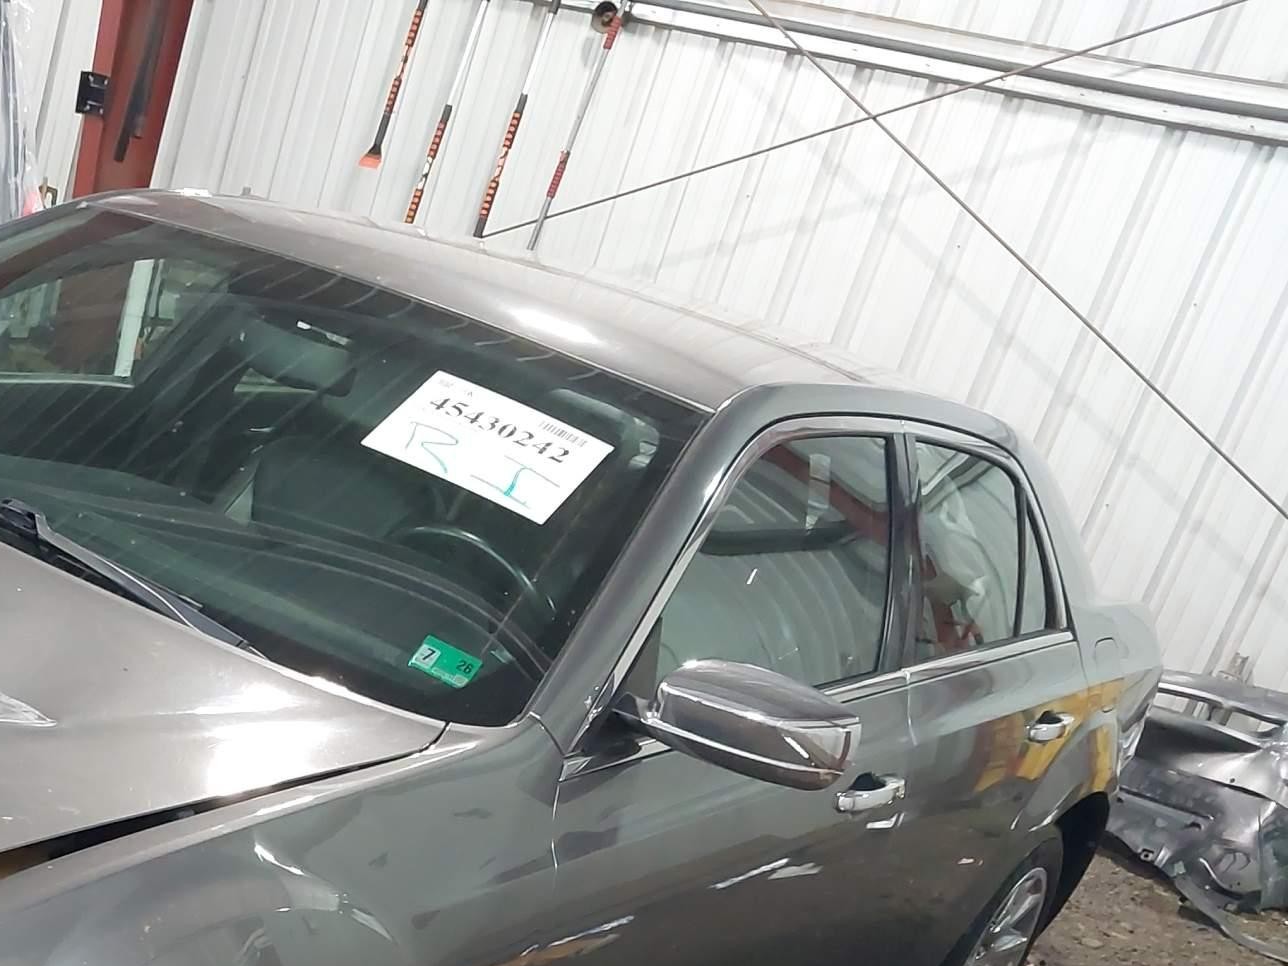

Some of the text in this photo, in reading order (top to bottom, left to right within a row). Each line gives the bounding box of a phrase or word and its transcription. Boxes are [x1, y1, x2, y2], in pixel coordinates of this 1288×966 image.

[429, 396, 571, 465] 45430242
[421, 647, 474, 674] 7 26
